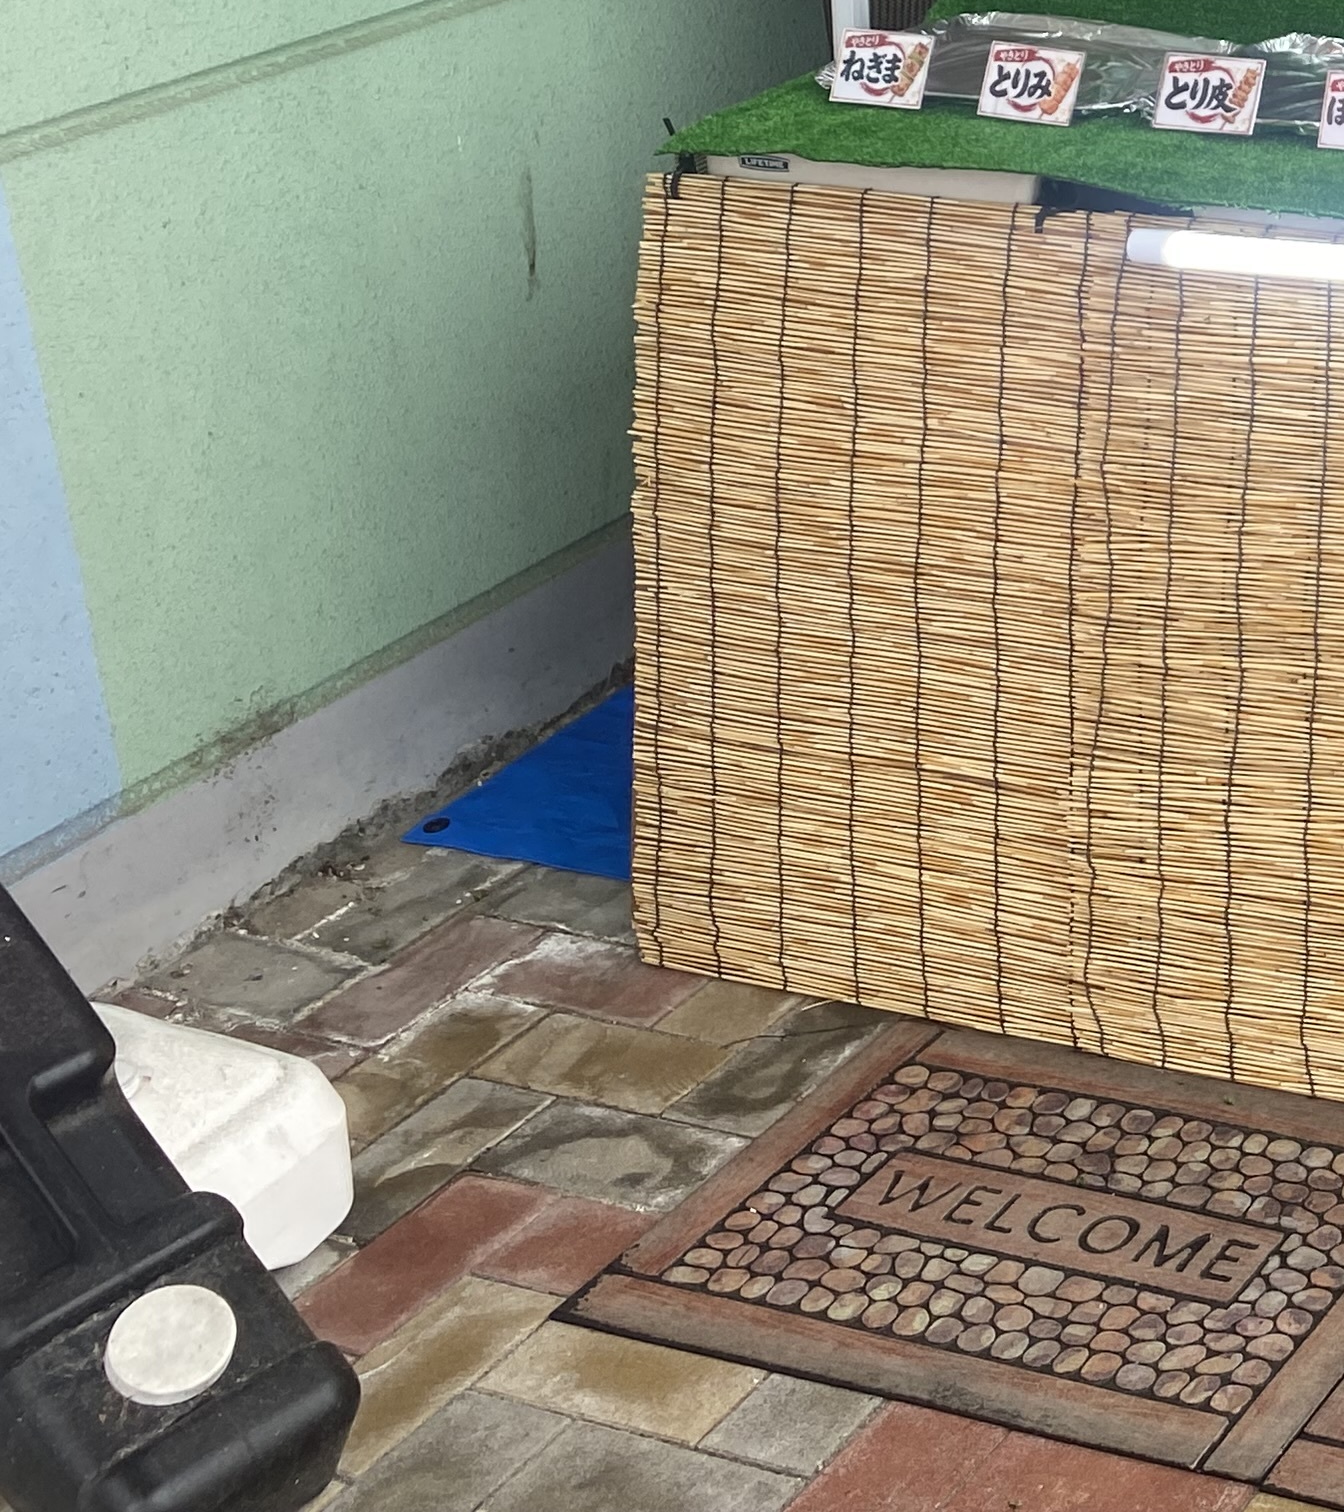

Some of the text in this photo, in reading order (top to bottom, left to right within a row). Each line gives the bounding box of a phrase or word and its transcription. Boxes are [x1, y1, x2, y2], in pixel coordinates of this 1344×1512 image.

[850, 35, 880, 48] やきとり
[999, 49, 1029, 62] やきとり
[840, 50, 902, 85] ねぎま
[988, 63, 1054, 101] とりみ
[1173, 59, 1206, 73] やきとり
[1163, 73, 1238, 113] とり皮
[878, 1169, 1260, 1284] WELCOME
